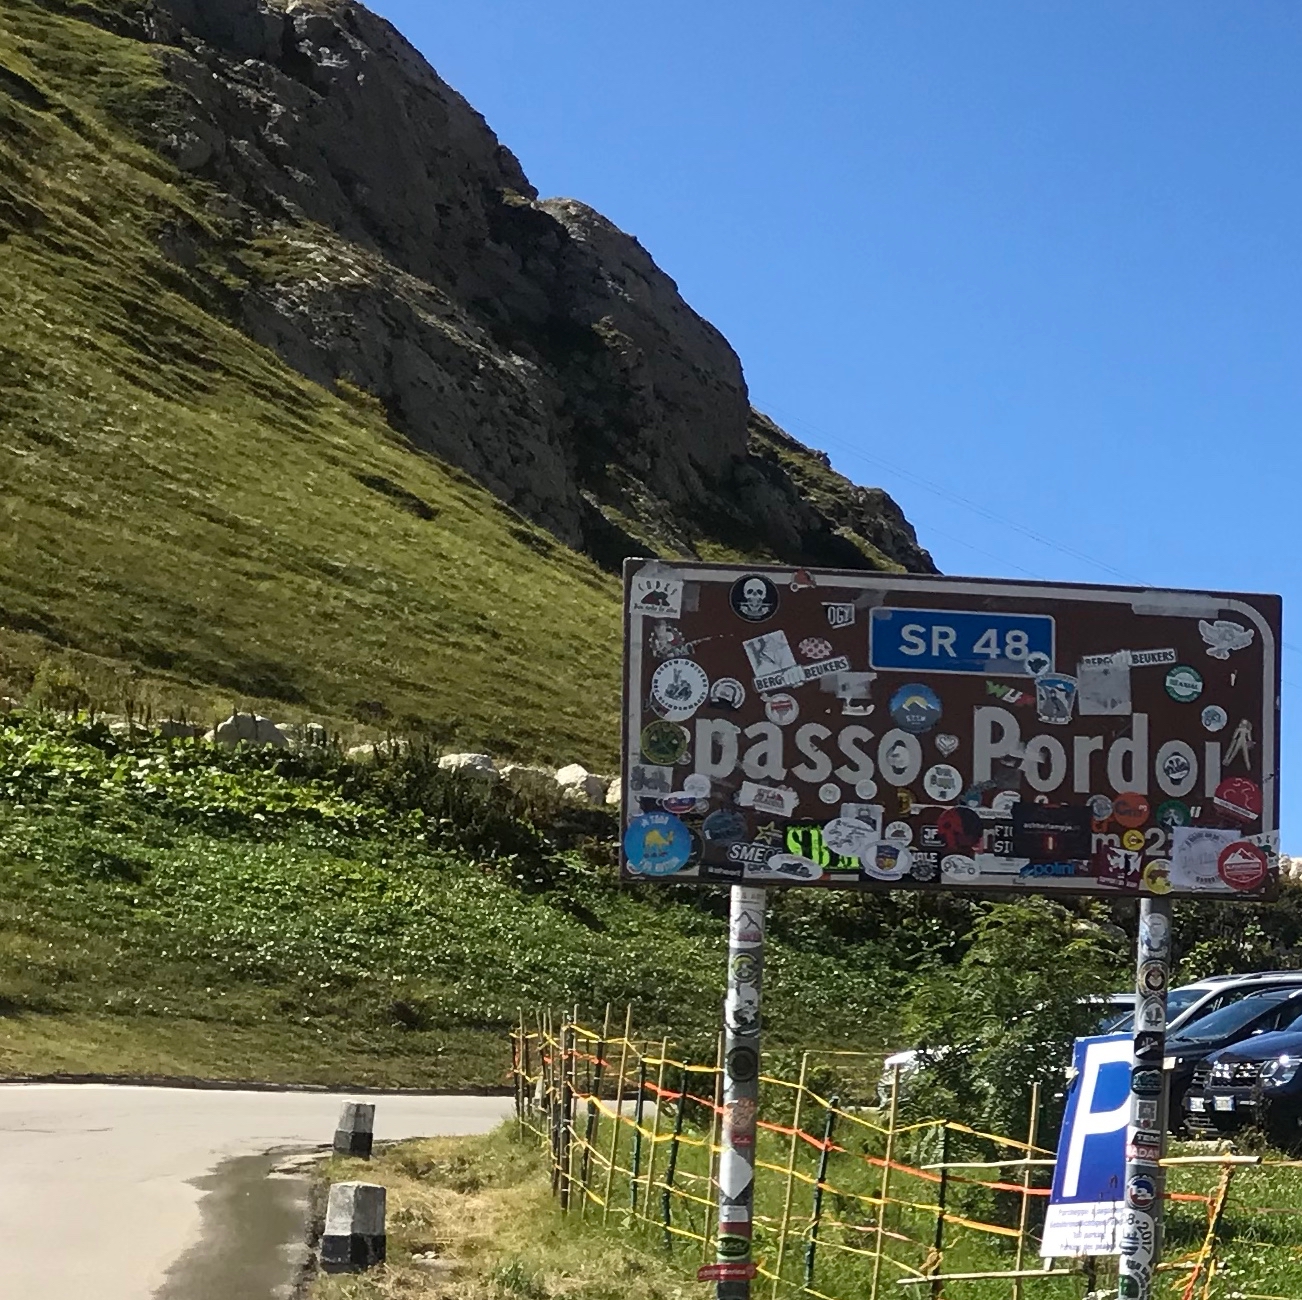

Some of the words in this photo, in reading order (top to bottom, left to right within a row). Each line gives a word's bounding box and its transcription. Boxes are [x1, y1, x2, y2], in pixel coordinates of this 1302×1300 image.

[898, 624, 957, 657] SR
[972, 629, 1029, 660] 48
[803, 658, 848, 679] BEUKERS
[1131, 650, 1175, 664] BEUKERS
[1062, 1043, 1134, 1198] P
